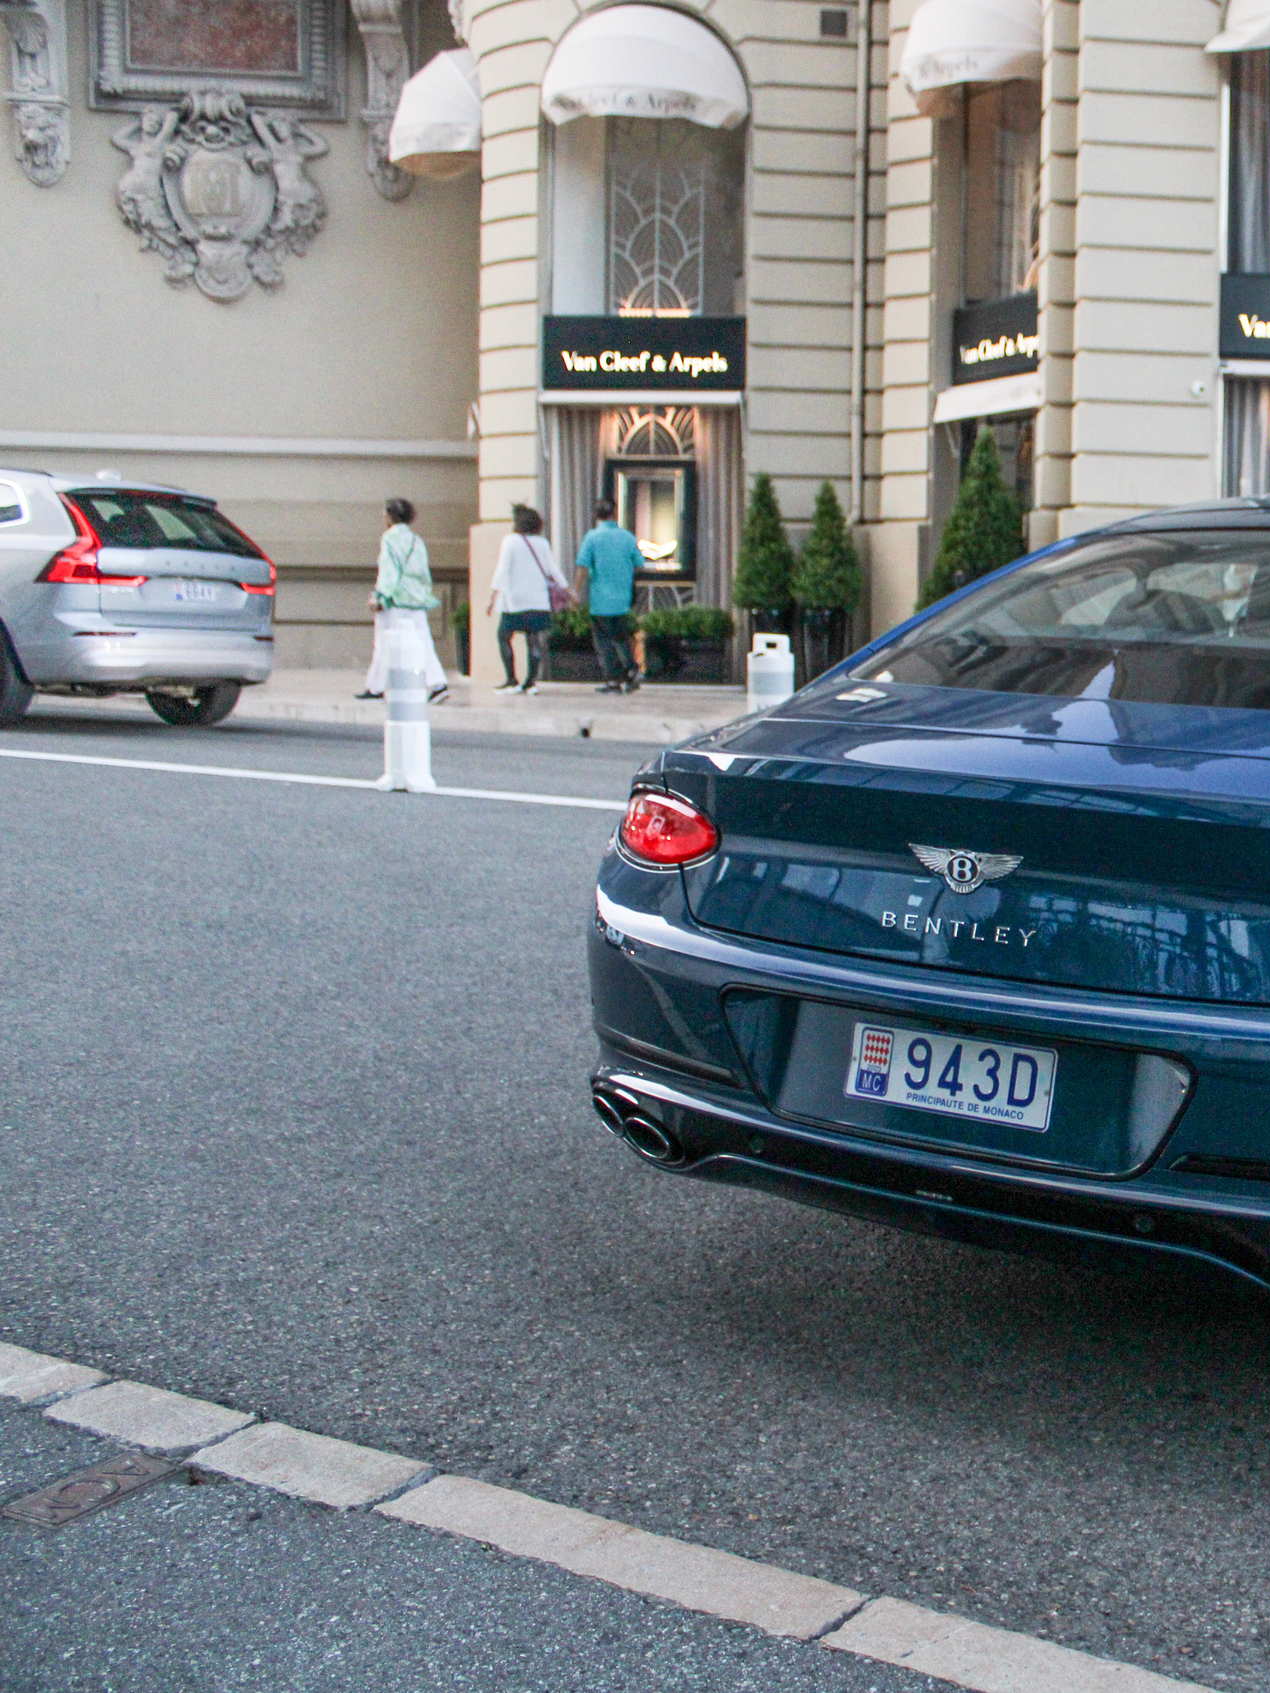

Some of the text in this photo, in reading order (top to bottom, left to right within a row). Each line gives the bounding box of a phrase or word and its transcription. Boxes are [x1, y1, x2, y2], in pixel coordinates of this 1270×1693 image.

[561, 350, 729, 378] Van Cleef & Arpels
[960, 345, 979, 364] Van
[978, 335, 1007, 361] Cleef
[952, 858, 972, 882] B
[881, 911, 1037, 947] BENTLEY
[862, 1073, 881, 1091] MC
[904, 1037, 1039, 1108] 943D
[906, 1092, 1024, 1121] PRINCIPAUTE DE MONACO
